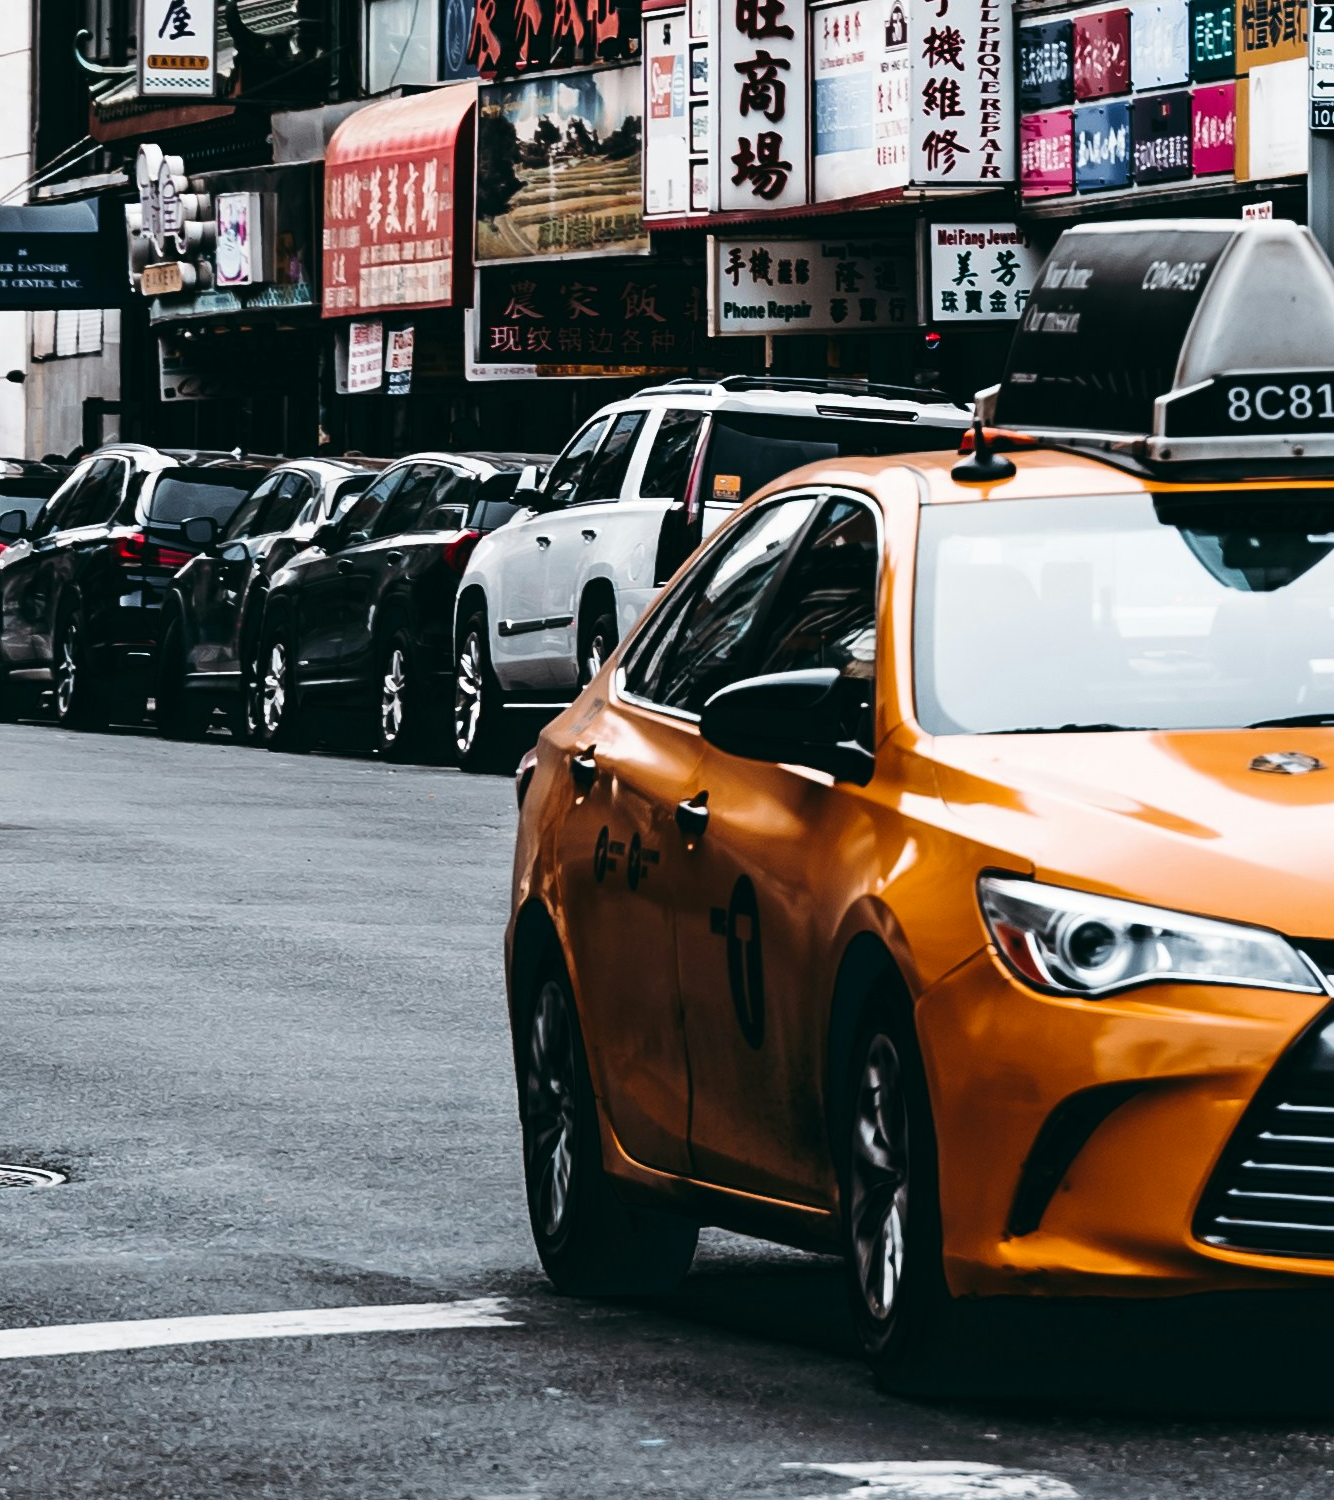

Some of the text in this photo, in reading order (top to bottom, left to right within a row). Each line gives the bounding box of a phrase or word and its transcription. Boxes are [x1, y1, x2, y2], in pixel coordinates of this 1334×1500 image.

[1319, 6, 1333, 31] 2
[150, 56, 209, 69] BAKERY
[976, 26, 1001, 94] PHONE
[978, 98, 1003, 179] REPAIR
[937, 229, 958, 246] Mei
[958, 229, 986, 249] Fang
[951, 249, 1021, 287] 美芳
[1141, 261, 1207, 290] COMPASS
[723, 300, 813, 323] Phone Repair
[940, 289, 1031, 314] 珠寶金行
